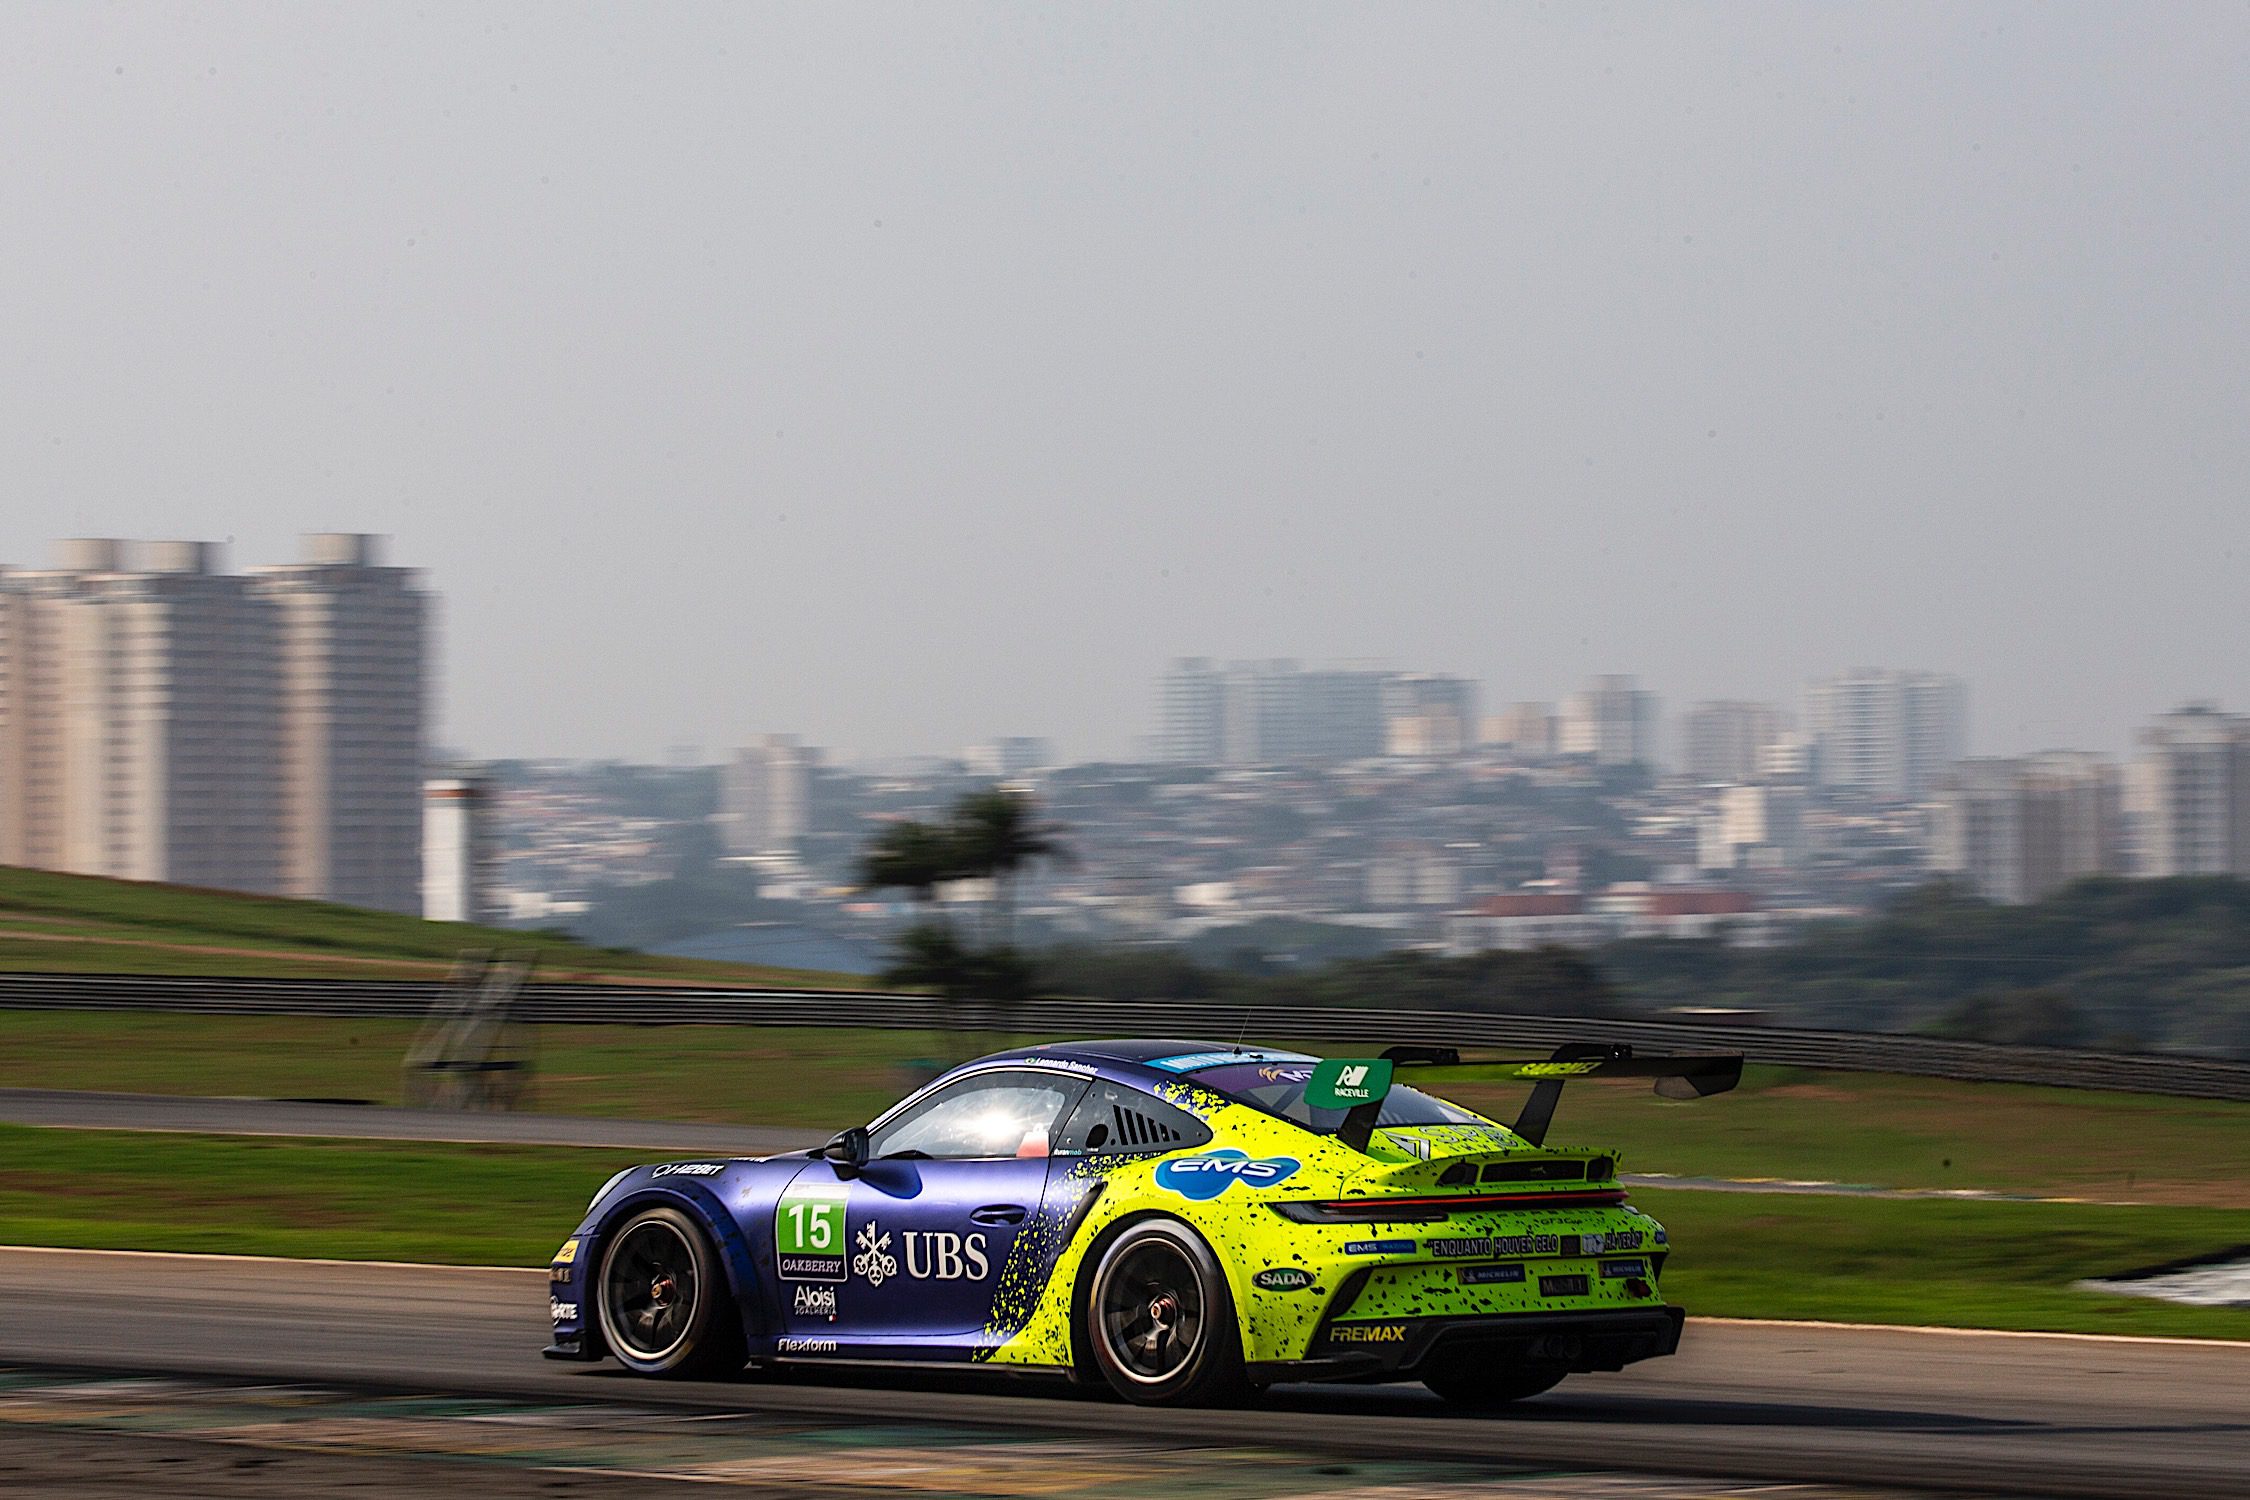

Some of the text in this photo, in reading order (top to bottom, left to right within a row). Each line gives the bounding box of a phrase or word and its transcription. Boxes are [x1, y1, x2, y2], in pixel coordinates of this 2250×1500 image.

[1036, 1058, 1098, 1074] Leonardo Sanchez
[1334, 1087, 1369, 1098] RACEVILLE
[1170, 1158, 1281, 1177] EMS
[788, 1203, 832, 1249] 15
[1348, 1243, 1377, 1253] EMS
[1536, 1235, 1559, 1252] GELO
[902, 1231, 989, 1281] UBS
[782, 1258, 842, 1273] OAKBERRY
[1260, 1272, 1307, 1285] SADA
[1477, 1270, 1519, 1279] MICHELIN
[794, 1285, 836, 1306] Aloisi
[1329, 1326, 1407, 1342] FREMAX
[777, 1337, 837, 1352] Flexform
